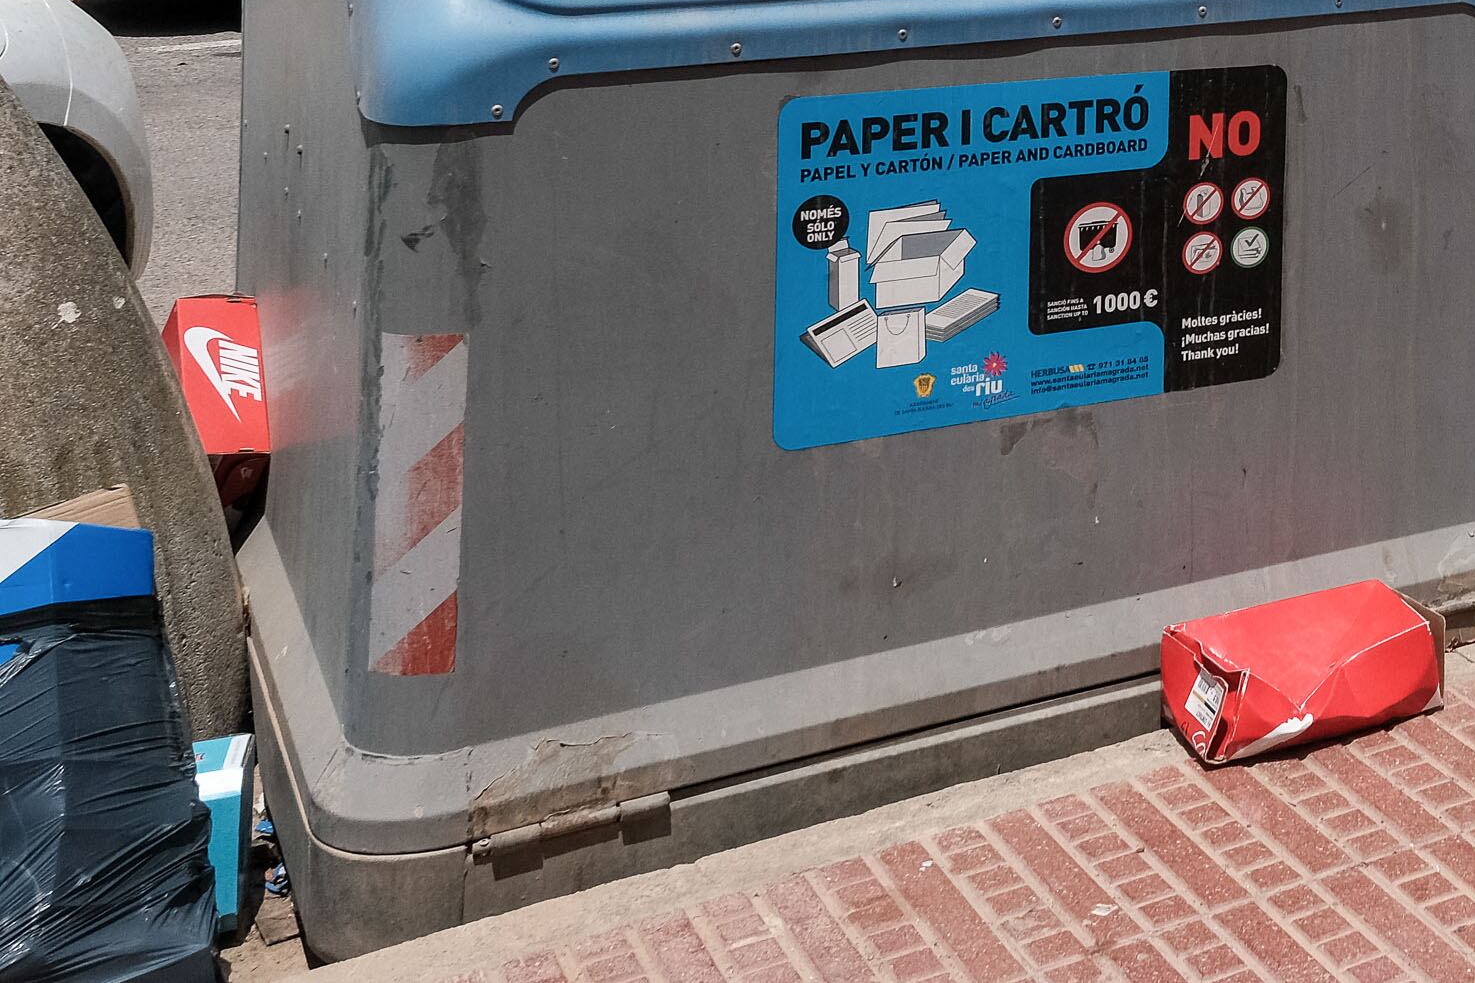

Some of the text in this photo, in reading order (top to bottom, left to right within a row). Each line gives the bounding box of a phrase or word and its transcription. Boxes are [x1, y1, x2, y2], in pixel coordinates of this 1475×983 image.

[801, 84, 1149, 160] PAPER I CARTRÓ
[1188, 110, 1261, 161] NO
[800, 165, 857, 183] PAPEL
[861, 163, 871, 177] Y
[875, 153, 943, 175] CARTÓN
[958, 147, 1011, 168] PAPER
[1016, 144, 1049, 162] AND
[1053, 138, 1148, 159] CARDBOARD
[800, 204, 842, 221] NOMÉS
[807, 220, 835, 232] SÓLO
[807, 231, 835, 242] ONLY
[1047, 305, 1070, 314] SANCIÓN
[1093, 288, 1158, 314] 1000 €
[1047, 312, 1073, 320] SANCTION
[1181, 308, 1262, 329] Moltes gràcies!
[1181, 323, 1270, 348] ¡Muchas gracias!
[1181, 343, 1239, 362] Thank you!
[218, 339, 262, 402] NIKE
[950, 363, 978, 375] santa
[1031, 365, 1070, 378] HERBUSA
[975, 377, 1003, 396] riu
